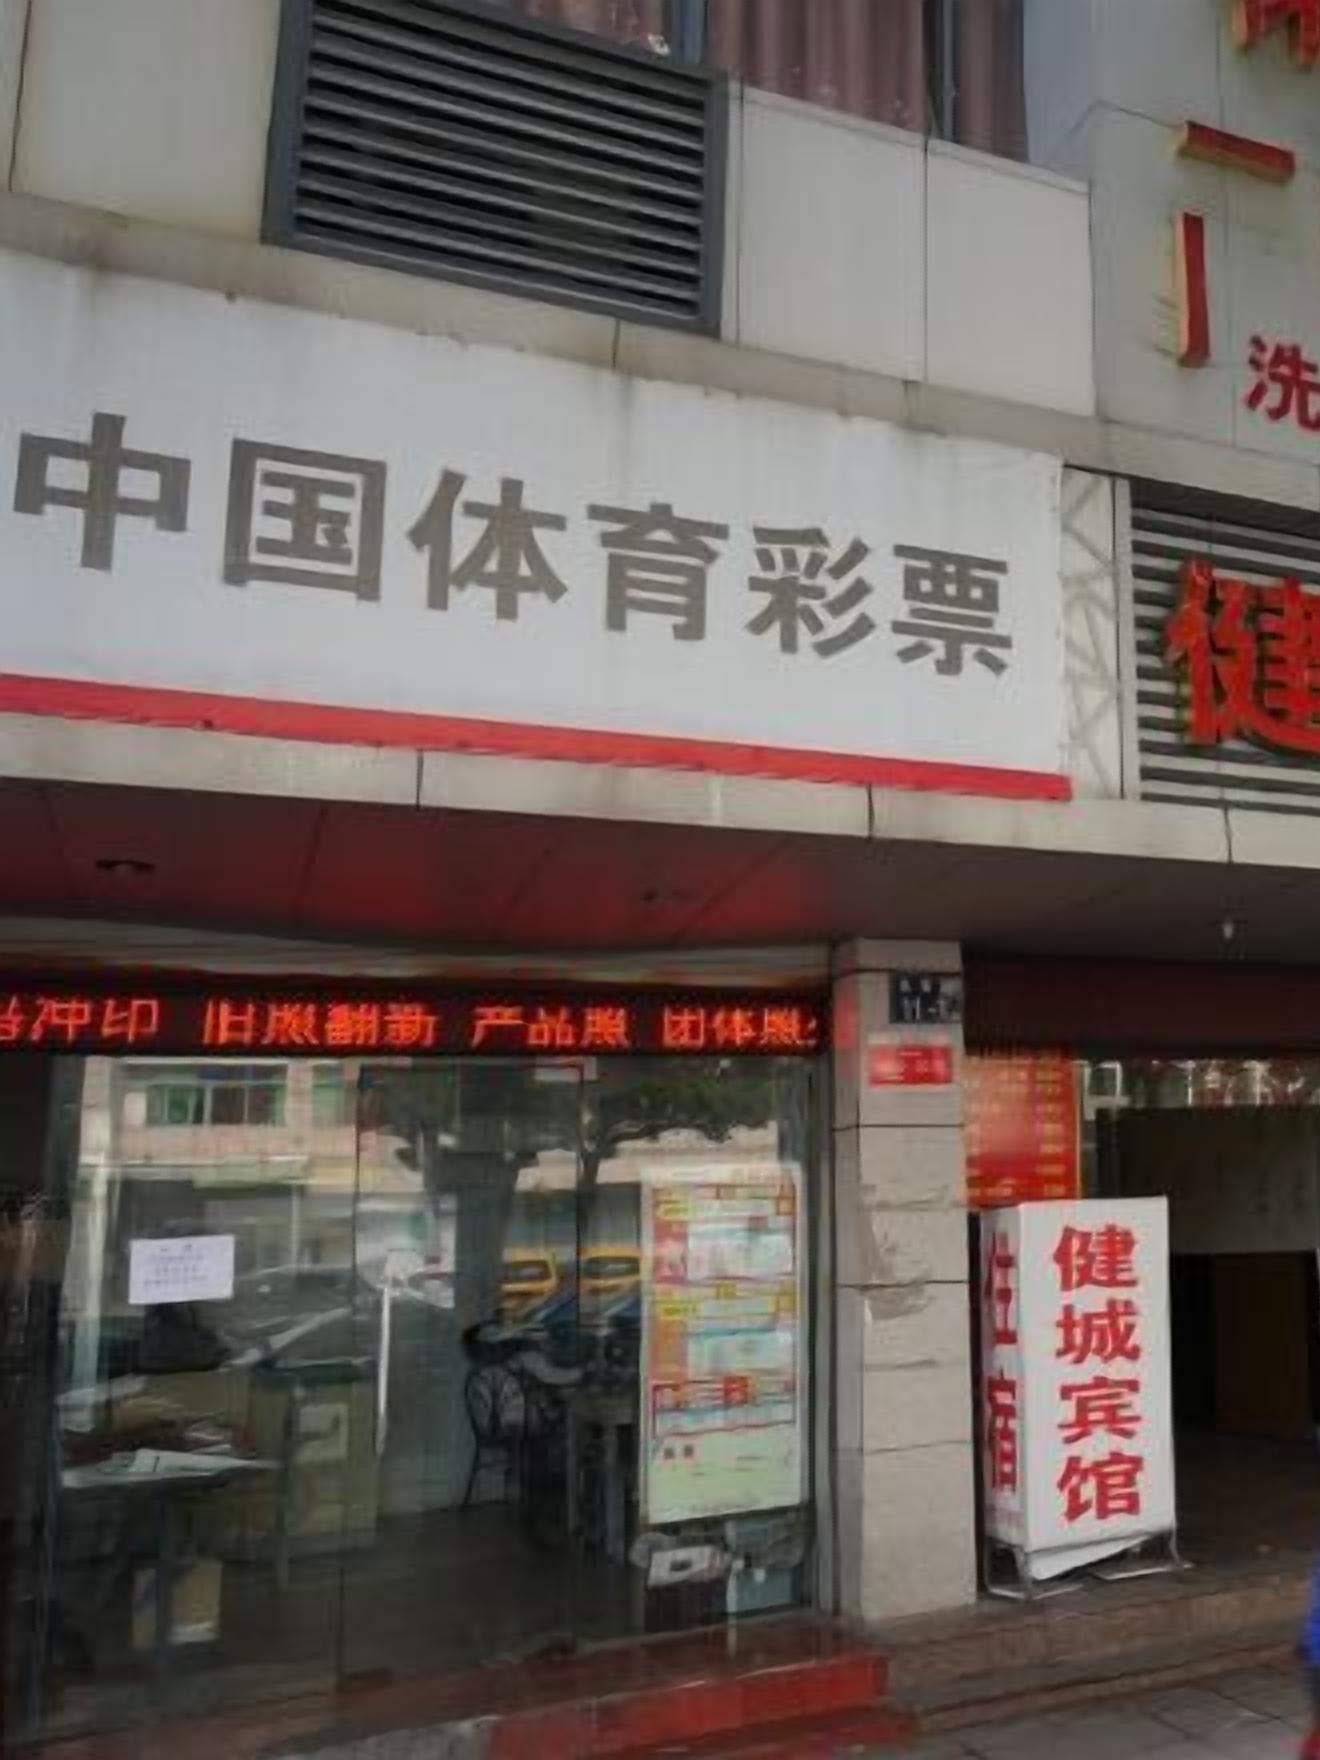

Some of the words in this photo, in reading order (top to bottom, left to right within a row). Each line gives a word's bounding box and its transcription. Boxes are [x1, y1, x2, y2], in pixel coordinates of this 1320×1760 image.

[12, 411, 1013, 677] 中国体育彩票
[202, 998, 440, 1046] 旧照翻新
[470, 1004, 630, 1048] 产品照
[1052, 1222, 1144, 1523] 健城宾馆
